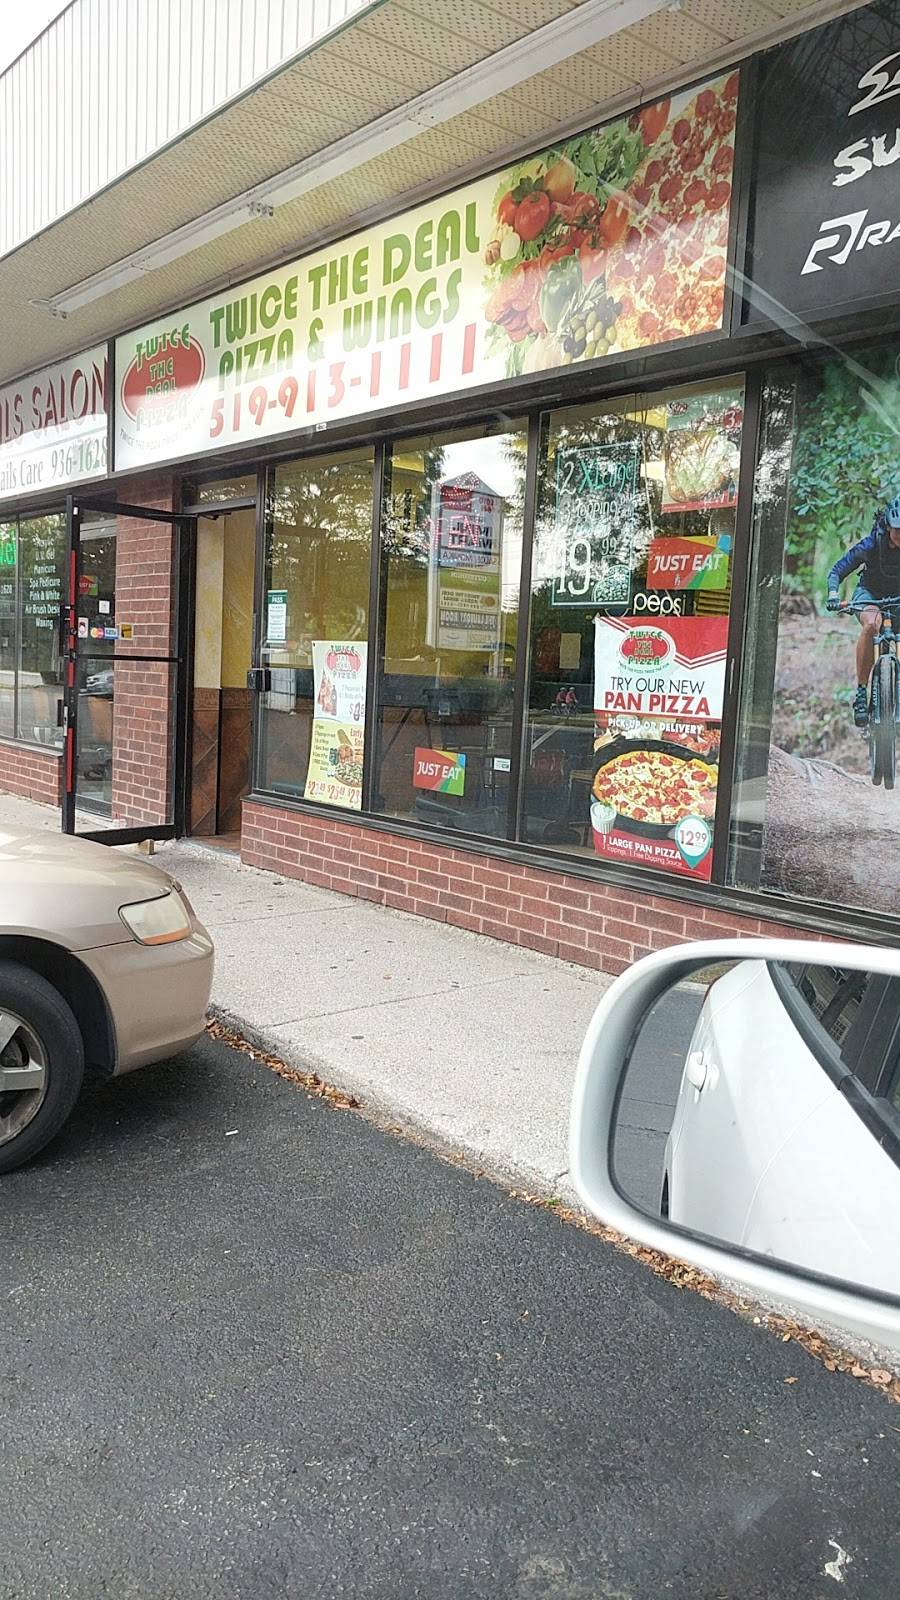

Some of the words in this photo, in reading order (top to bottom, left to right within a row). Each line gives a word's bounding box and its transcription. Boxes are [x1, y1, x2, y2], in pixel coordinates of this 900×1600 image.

[210, 276, 298, 348] TWICE
[308, 246, 369, 312] THE
[382, 202, 480, 287] DEAL
[219, 327, 294, 392] PIZZA
[308, 317, 325, 364] &
[343, 268, 463, 353] WINGS
[136, 323, 191, 372] TWICE
[149, 357, 174, 382] THE
[210, 323, 477, 439] 519-913-1111
[32, 356, 108, 430] SALON
[146, 377, 176, 401] DEAL
[20, 459, 43, 487] Care
[560, 461, 576, 495] 2
[652, 554, 690, 575] JUST
[692, 553, 723, 572] EAT
[633, 592, 687, 618] pepsi
[630, 630, 662, 641] TWICE
[628, 655, 660, 666] PIZZA
[611, 677, 632, 692] TRY
[636, 677, 664, 693] OUR
[669, 679, 705, 695] NEW
[604, 691, 642, 711] PAN
[649, 694, 711, 716] PIZZA
[660, 721, 705, 735] DELIVERY
[416, 761, 442, 777] JUST
[442, 765, 462, 781] EAT
[608, 836, 634, 850] LARGE
[635, 842, 653, 854] PAN
[654, 846, 682, 860] PIZZA
